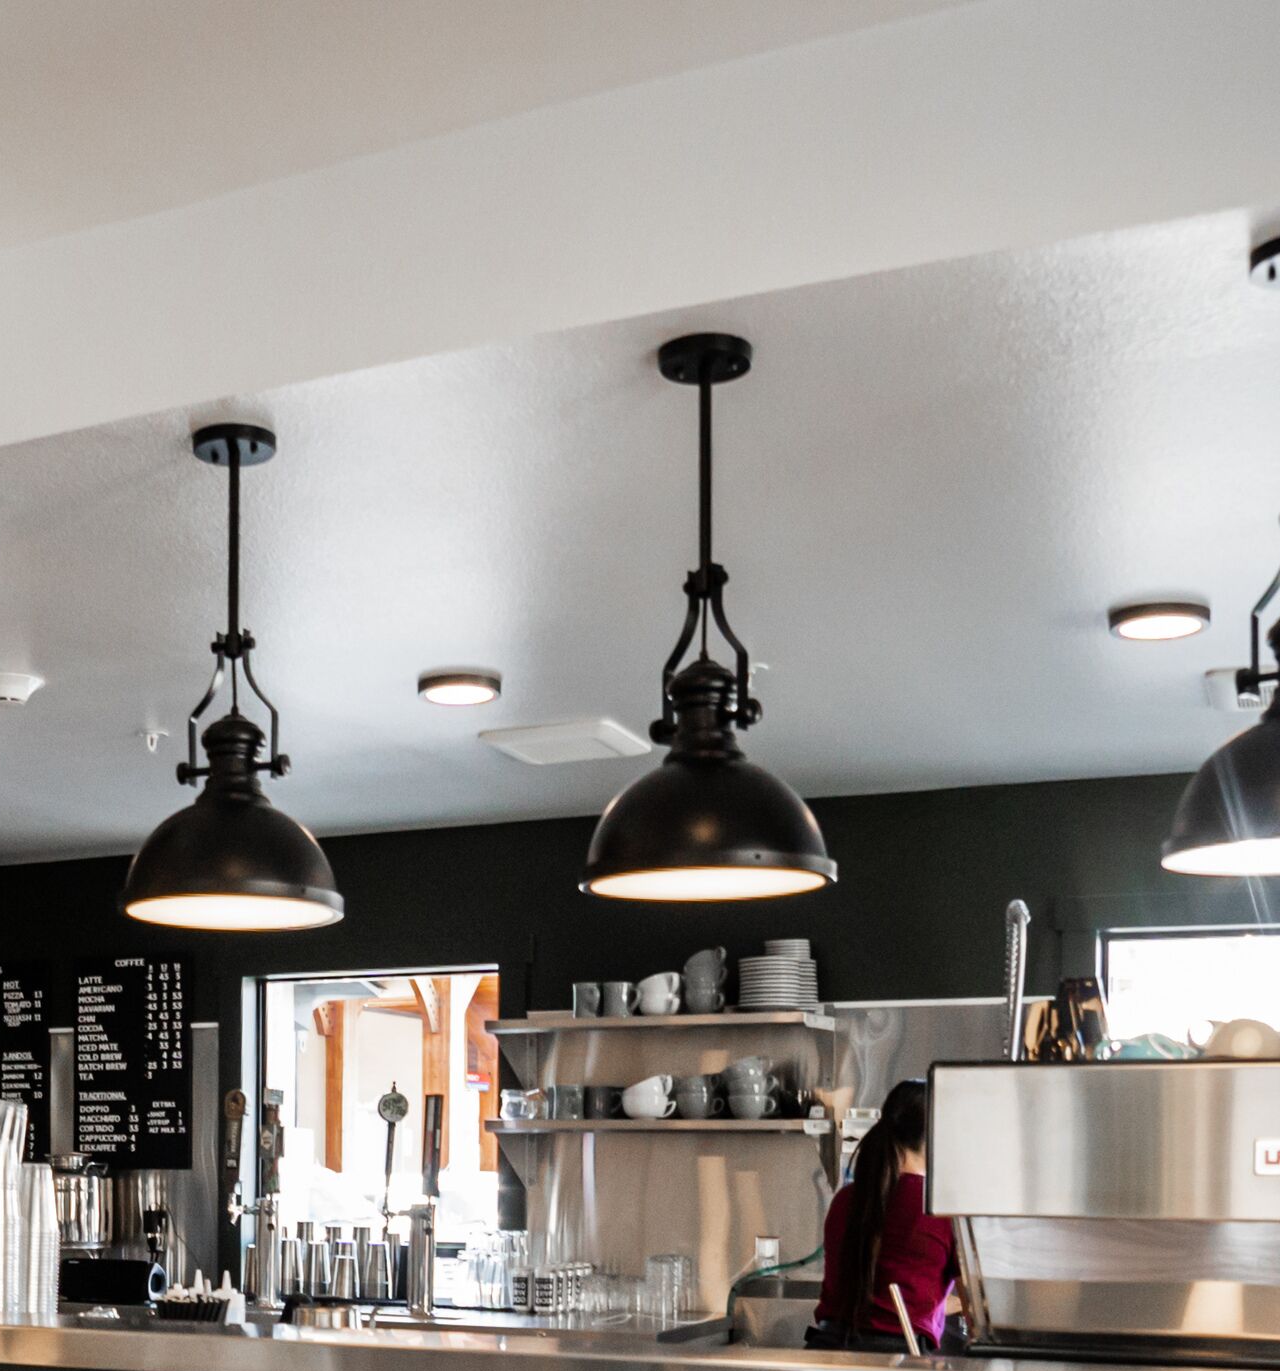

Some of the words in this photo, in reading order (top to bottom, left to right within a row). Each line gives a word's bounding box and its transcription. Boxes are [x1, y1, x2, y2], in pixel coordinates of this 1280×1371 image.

[115, 958, 145, 967] COFFEE
[78, 976, 103, 984] LATTE
[79, 985, 123, 994] AMERICANO
[78, 996, 105, 1004] MOCHA
[79, 1005, 115, 1013] BAVARIAN
[78, 1024, 104, 1032] COCOA
[78, 1034, 108, 1042] MATCHA
[78, 1043, 97, 1051] ICED
[99, 1043, 118, 1051] MATE
[78, 1053, 99, 1061] COLD
[101, 1053, 122, 1061] BREW
[78, 1063, 104, 1071] BATCH
[105, 1062, 127, 1070] BREW
[33, 1091, 42, 1099] 10
[79, 1092, 127, 1101] TRADITIONAL
[79, 1105, 110, 1113] DOPPIO
[79, 1115, 121, 1123] MACCHIATO
[79, 1125, 115, 1133] CORTADO
[79, 1134, 127, 1142] CAPPUCCINO
[79, 1144, 117, 1152] EISKAFFEE
